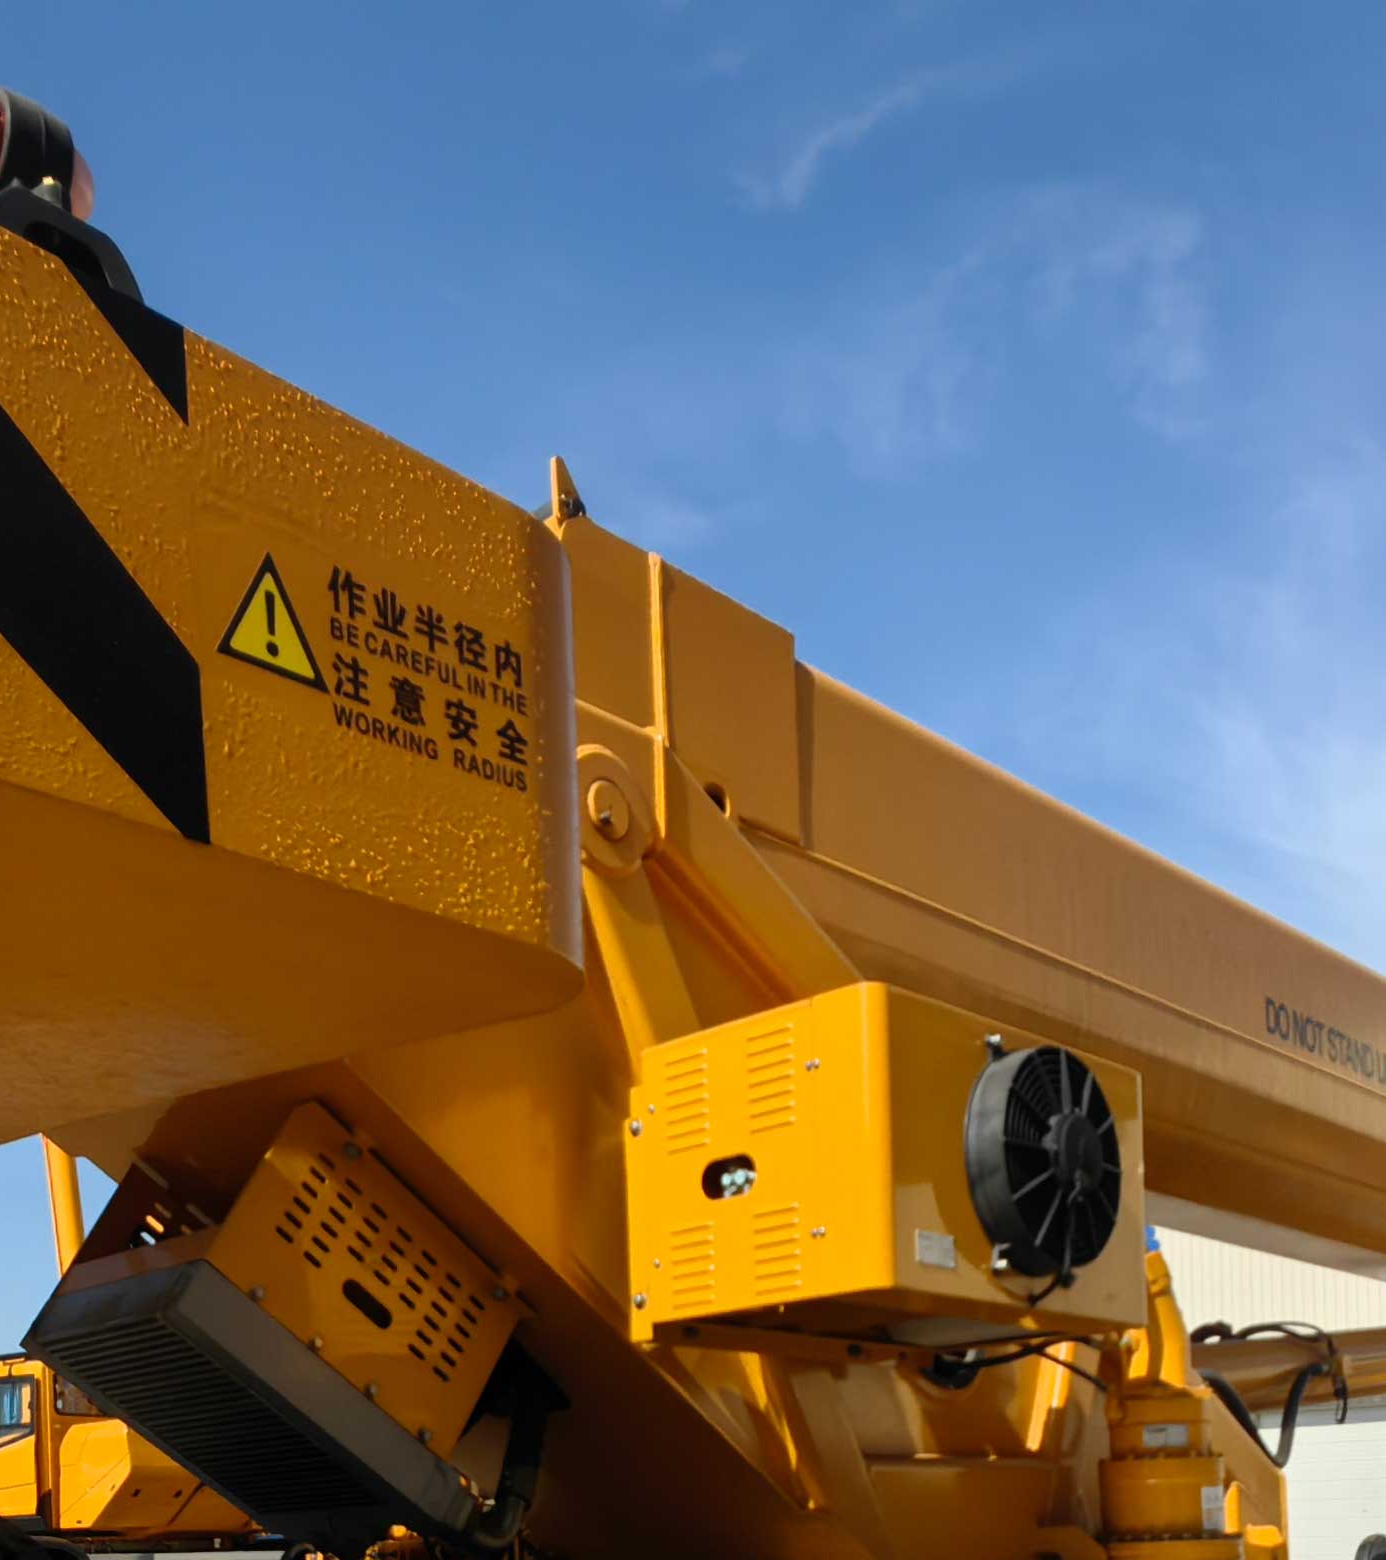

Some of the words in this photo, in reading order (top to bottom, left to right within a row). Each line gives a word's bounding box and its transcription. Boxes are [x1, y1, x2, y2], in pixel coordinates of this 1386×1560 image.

[328, 565, 522, 688] 作业半径内
[330, 615, 360, 649] BE
[364, 631, 464, 691] CAREFUL
[467, 673, 486, 700] IN
[490, 681, 529, 718] THE
[332, 652, 528, 767] 注意安全
[333, 701, 439, 760] WORKING
[453, 748, 528, 793] RADIUS
[1265, 996, 1291, 1041] DO
[1292, 1008, 1326, 1057] NOT
[1327, 1027, 1374, 1078] STAND
